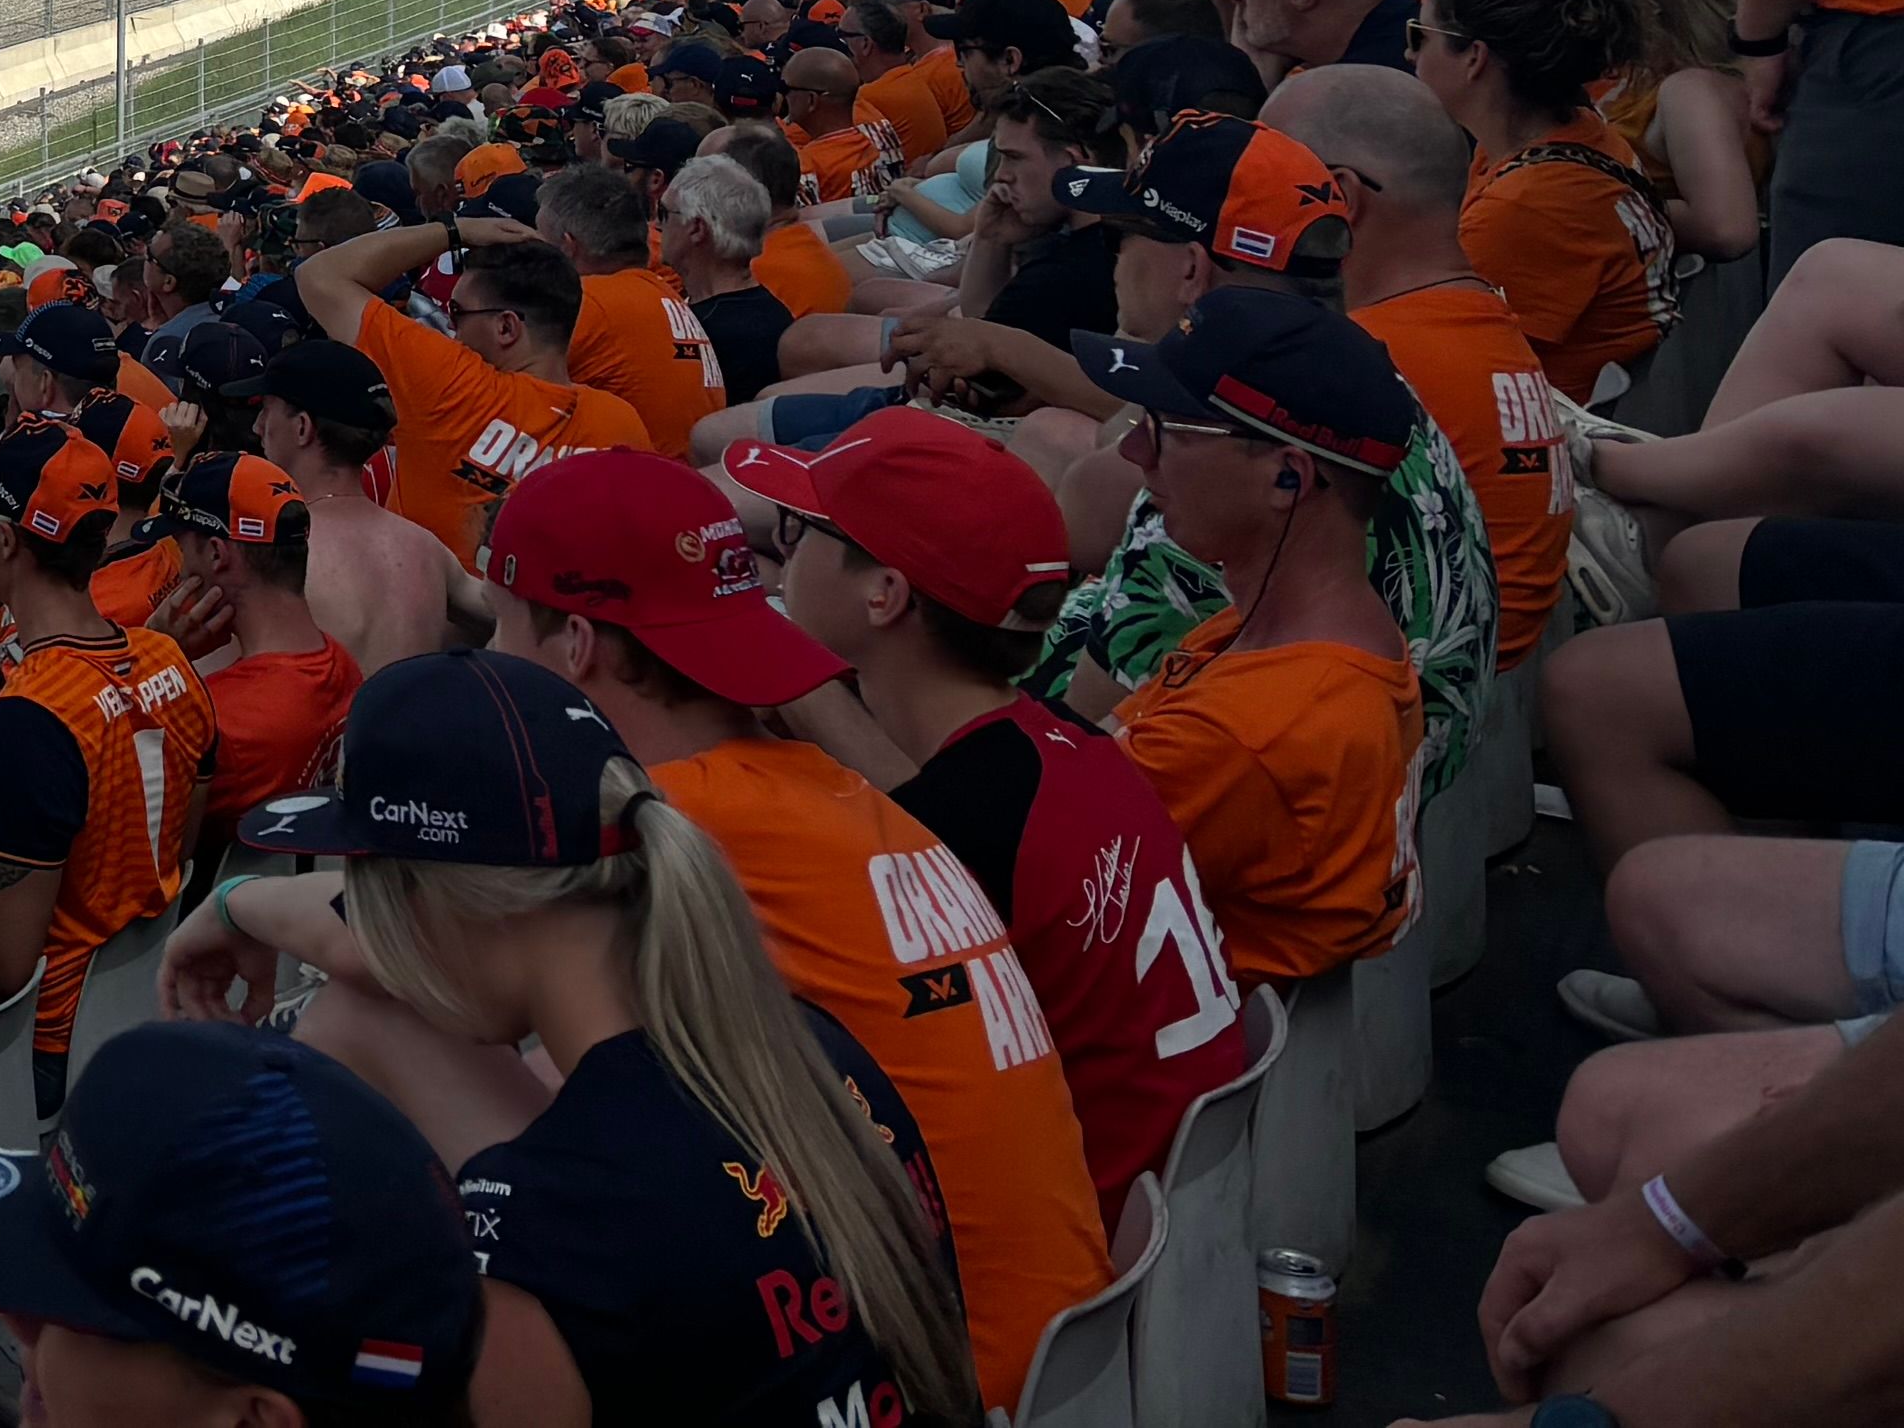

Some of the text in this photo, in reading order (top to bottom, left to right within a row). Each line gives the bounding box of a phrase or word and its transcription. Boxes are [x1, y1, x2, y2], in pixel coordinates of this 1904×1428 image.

[1158, 202, 1207, 233] viaplay
[370, 796, 468, 831] CarNext
[417, 826, 460, 845] .com
[130, 1266, 296, 1365] CarNext
